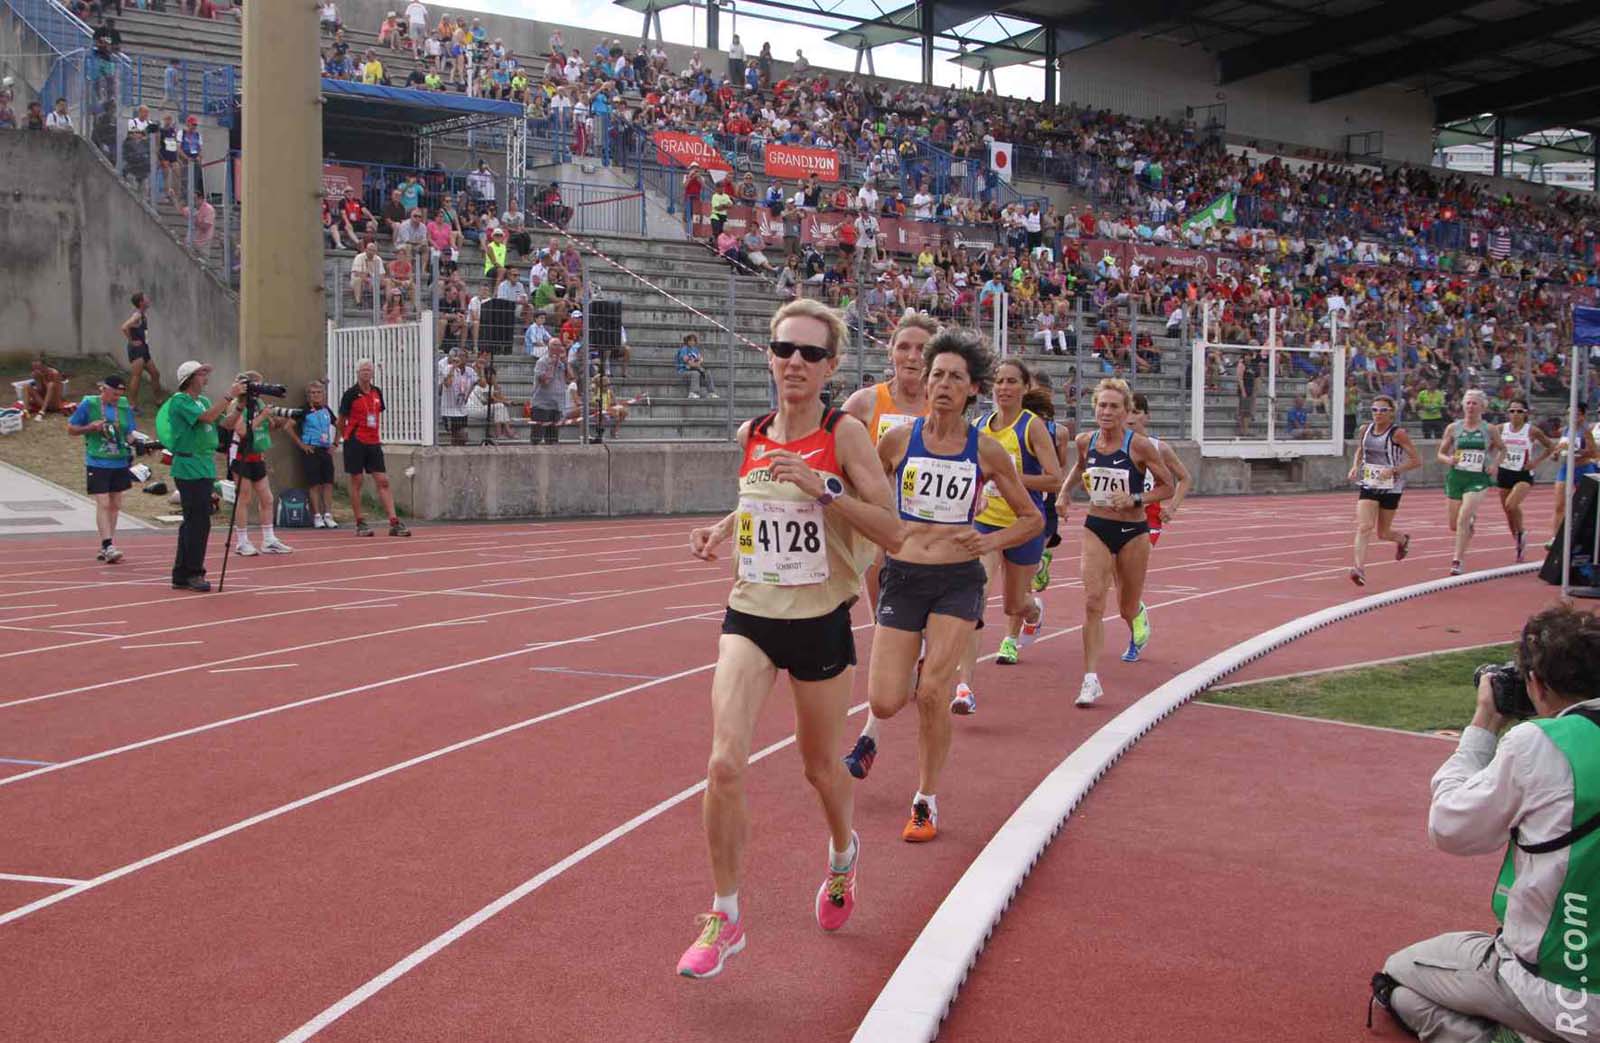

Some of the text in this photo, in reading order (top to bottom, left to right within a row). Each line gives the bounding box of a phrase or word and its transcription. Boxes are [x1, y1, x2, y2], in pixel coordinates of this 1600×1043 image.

[769, 151, 835, 170] GRANDLYON
[906, 470, 915, 480] W
[903, 481, 914, 491] 55
[919, 472, 973, 500] 2167
[1093, 476, 1125, 491] 7761
[741, 519, 751, 531] W
[739, 535, 752, 546] 55
[758, 519, 821, 554] 4128
